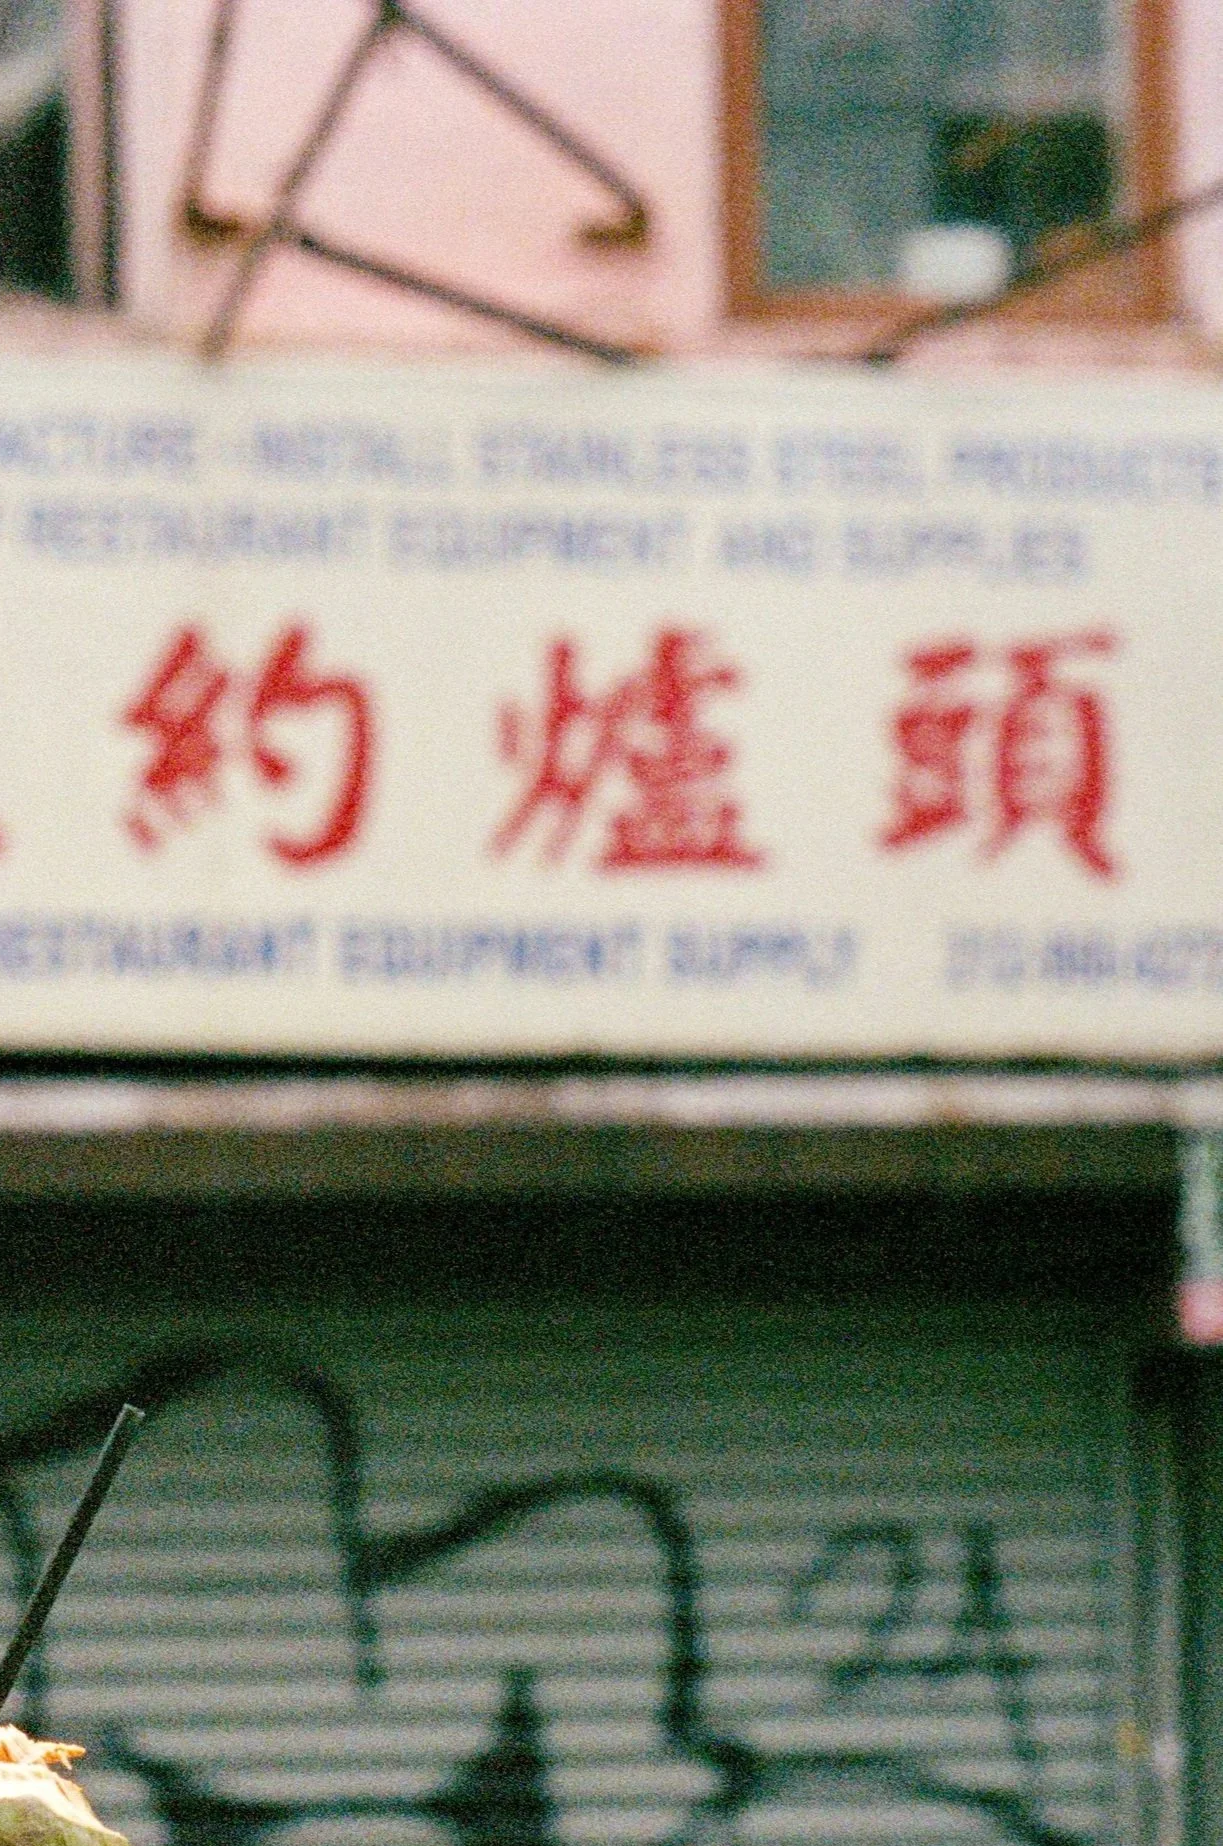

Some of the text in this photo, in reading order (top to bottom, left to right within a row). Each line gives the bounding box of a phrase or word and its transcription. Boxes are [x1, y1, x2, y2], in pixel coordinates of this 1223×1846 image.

[248, 421, 460, 486] INSTALL
[472, 424, 754, 492] STAINLESS
[767, 432, 924, 496] STEEL
[20, 500, 368, 564] RESTAURANT
[387, 512, 688, 572] EQUIPMENT
[714, 516, 822, 575] AND
[835, 519, 1091, 582] SUPPLIES
[336, 919, 644, 983] EQUIPMENT
[661, 921, 861, 985] SUPPLY
